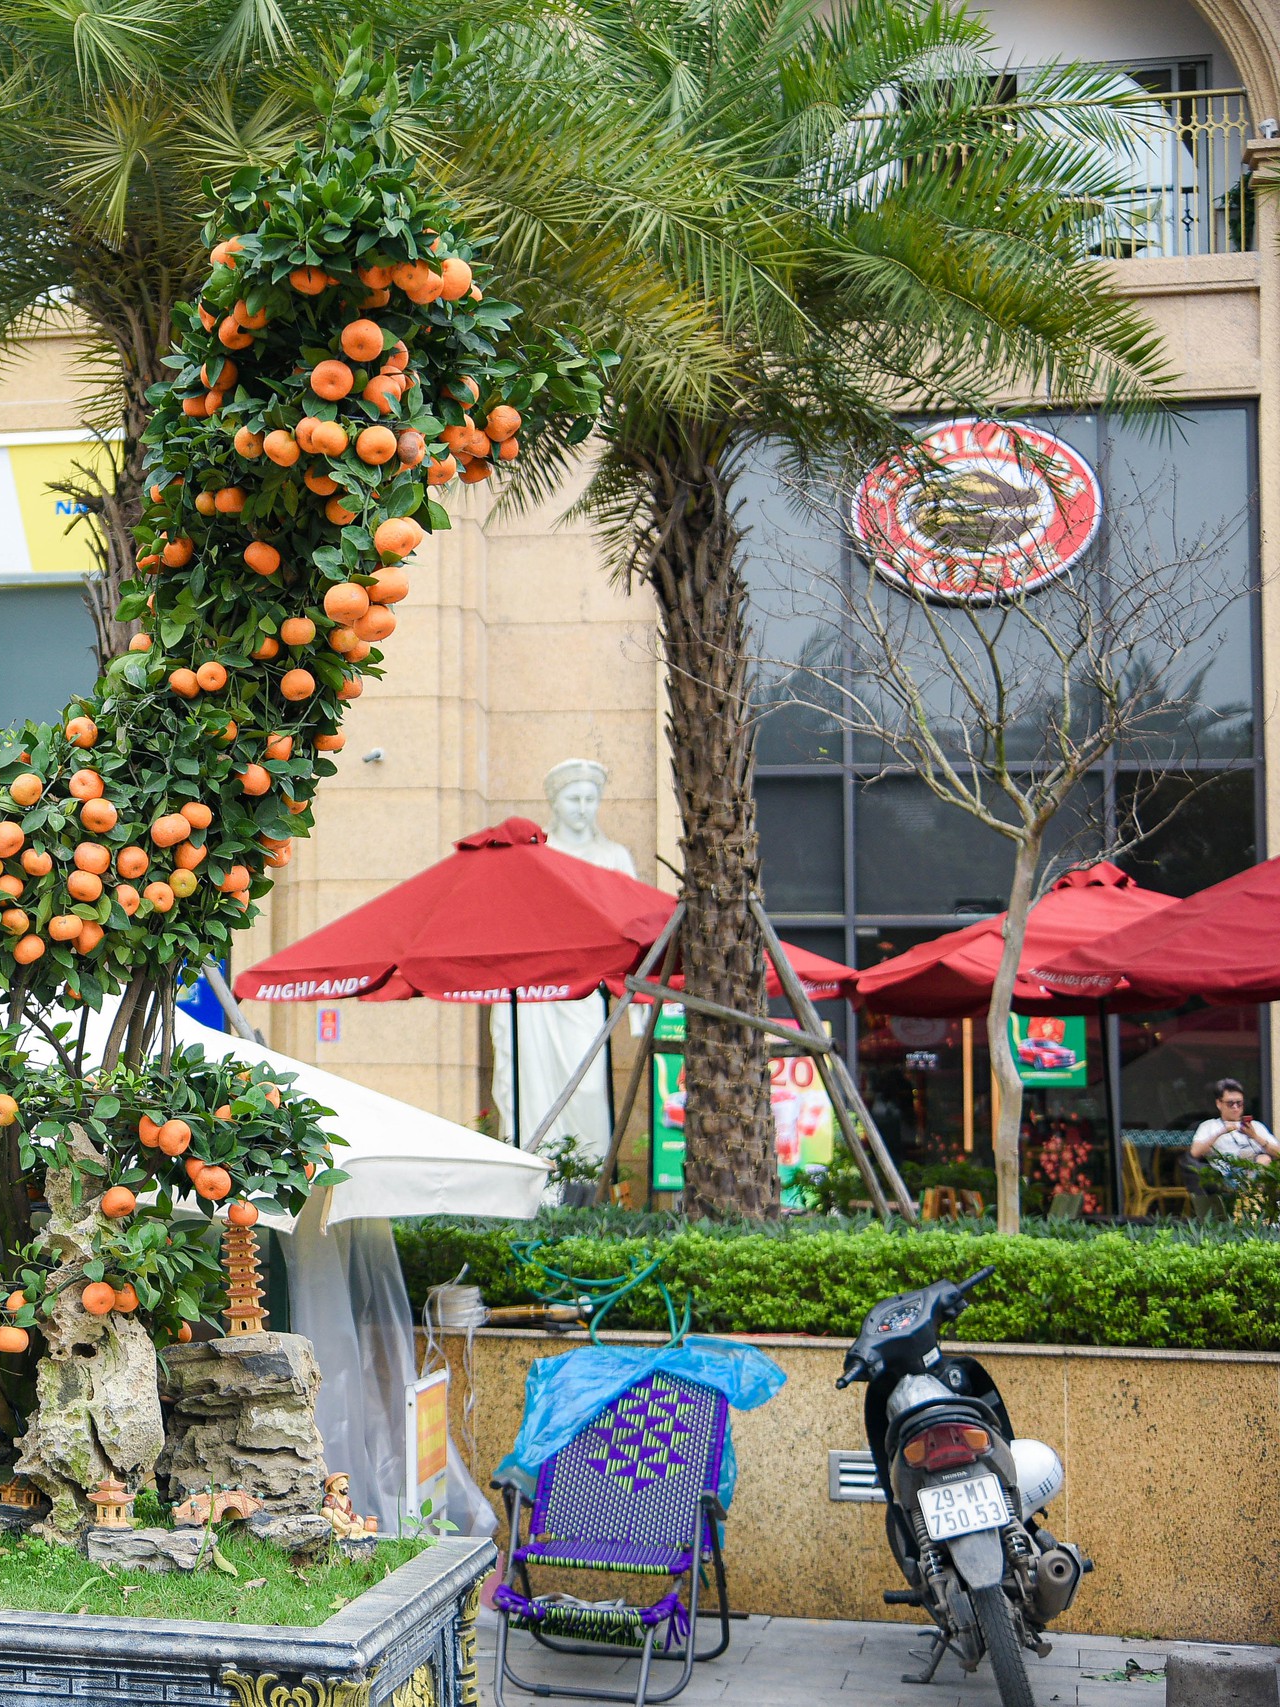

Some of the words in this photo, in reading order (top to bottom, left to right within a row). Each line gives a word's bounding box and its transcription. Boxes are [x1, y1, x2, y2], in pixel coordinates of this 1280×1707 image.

[255, 975, 370, 999] HIGHLANDS
[930, 1480, 990, 1511] 29-M1
[930, 1501, 1003, 1535] 750.53
